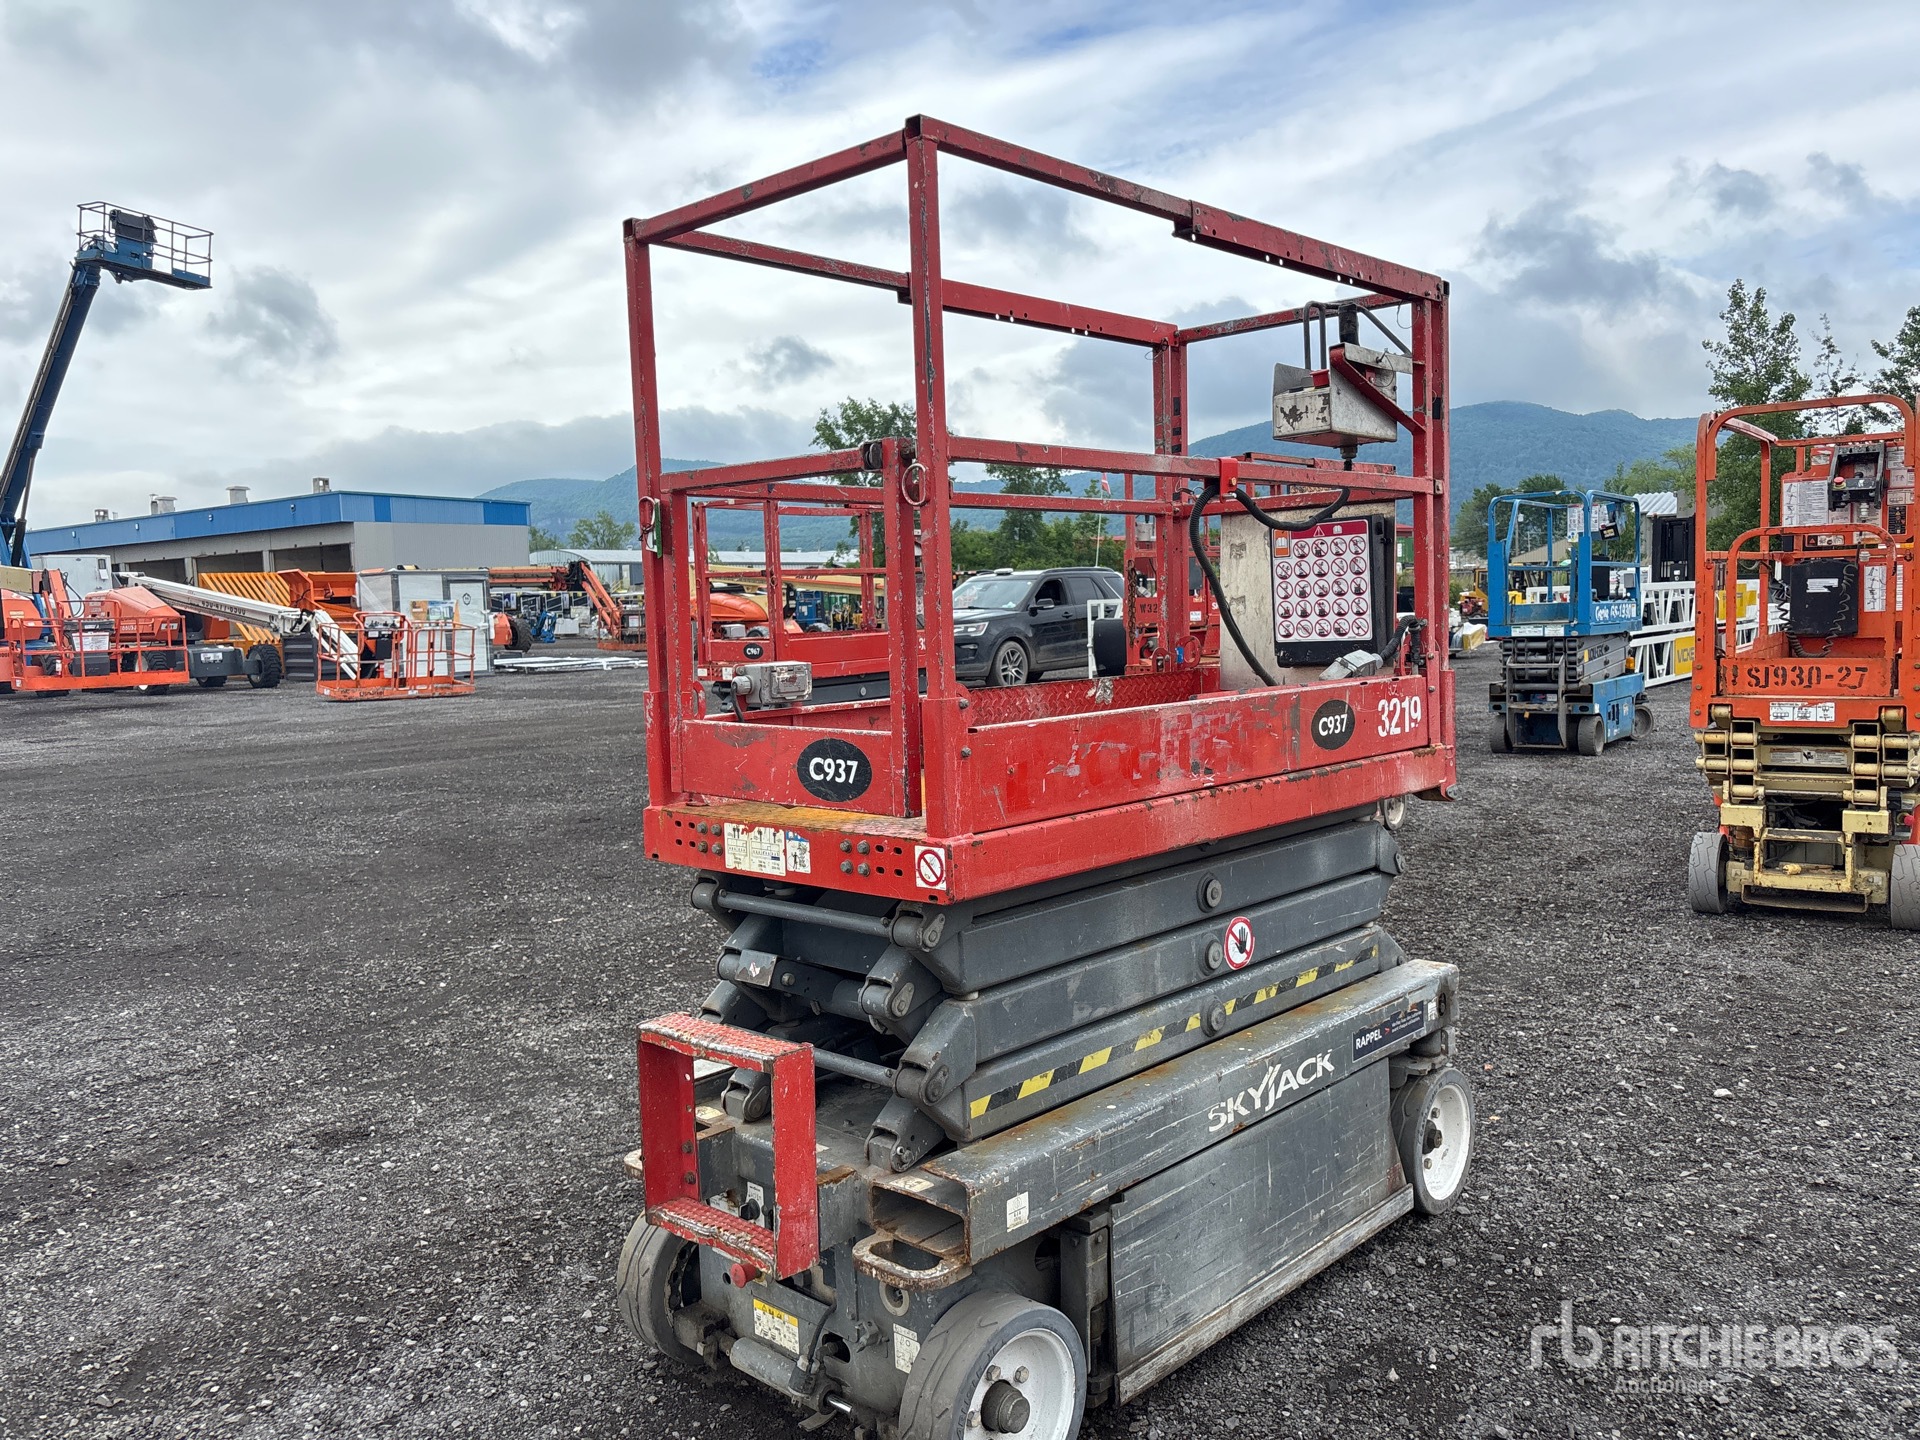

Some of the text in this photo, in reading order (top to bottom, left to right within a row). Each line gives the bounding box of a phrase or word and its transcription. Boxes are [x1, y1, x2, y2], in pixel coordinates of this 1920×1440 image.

[746, 646, 760, 656] C967
[1747, 665, 1868, 689] SJ930-27
[1318, 713, 1348, 736] C937
[1377, 696, 1421, 737] 3219
[809, 757, 858, 784] C937
[1355, 1028, 1382, 1050] RAPPEL
[1208, 1049, 1335, 1133] SKYJACK
